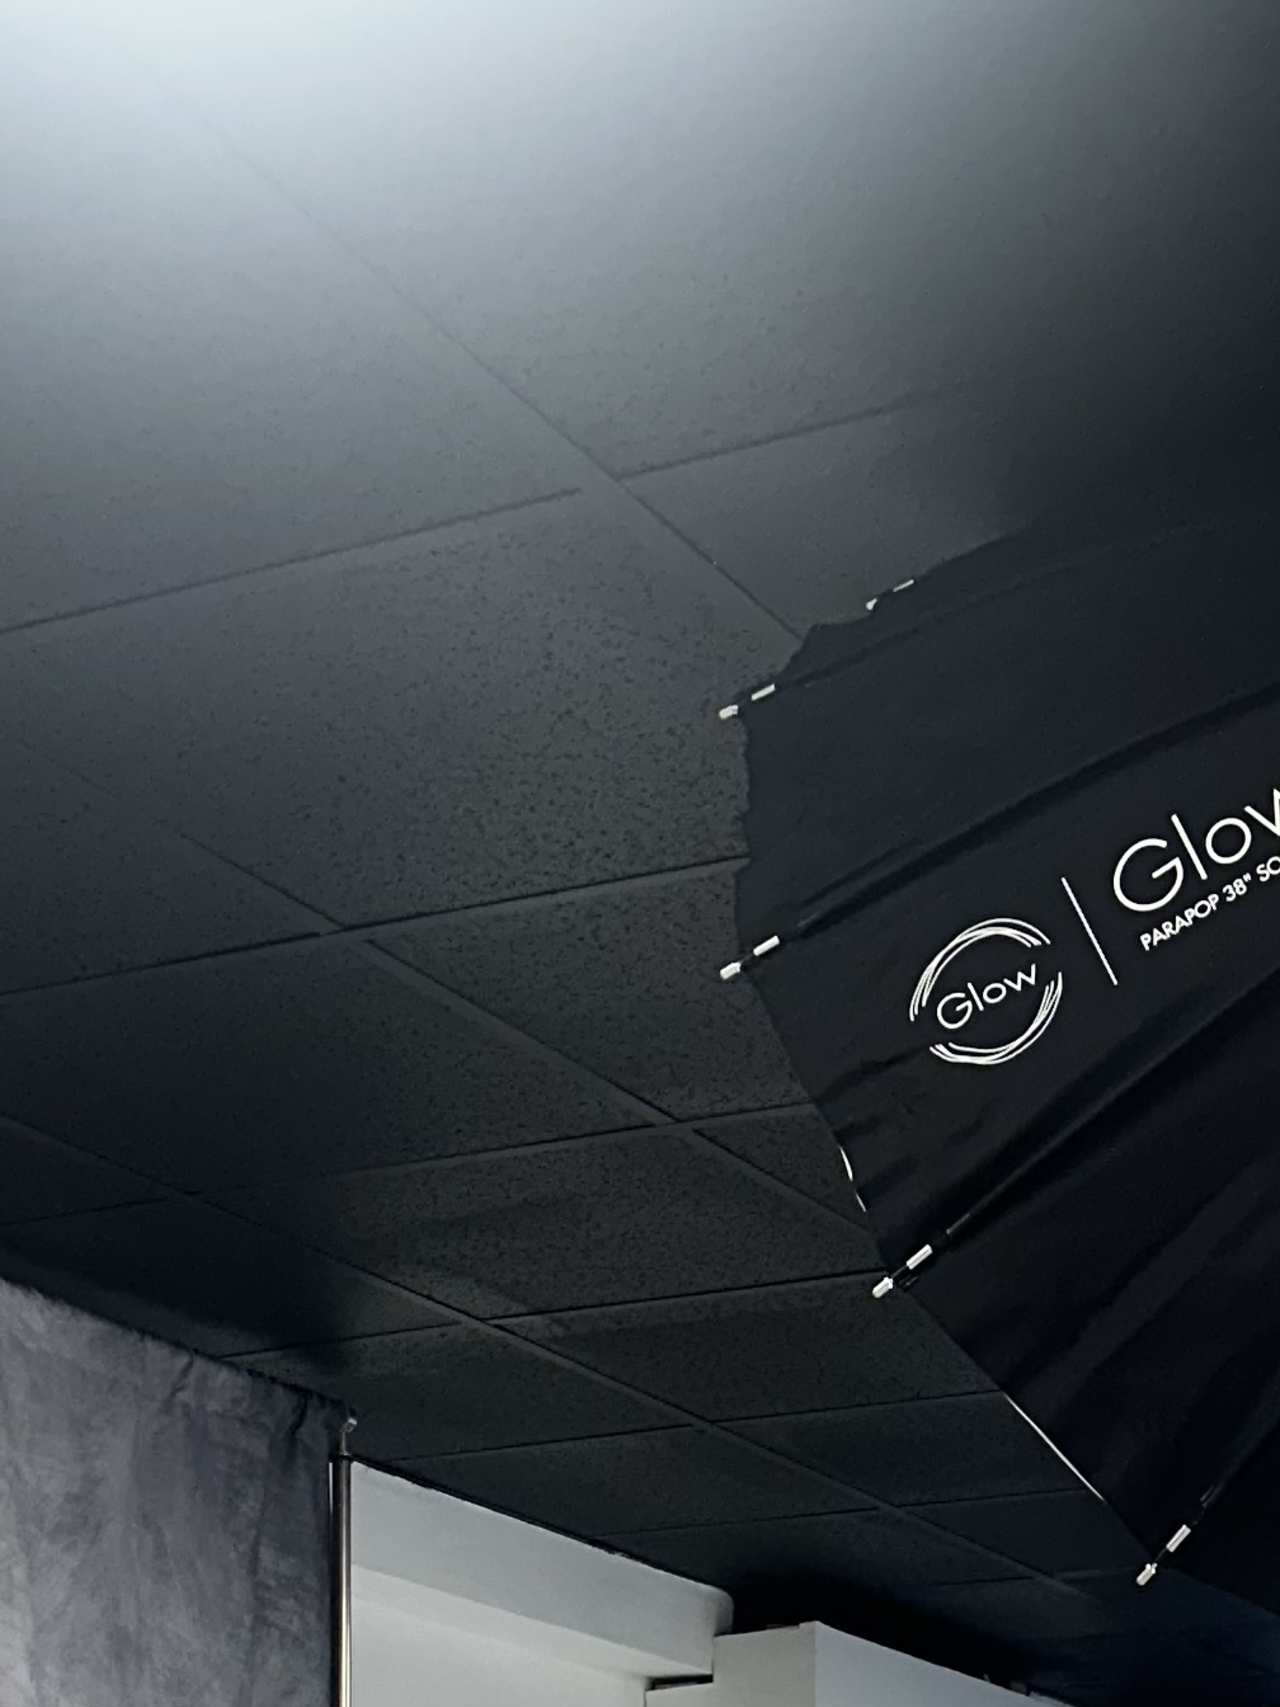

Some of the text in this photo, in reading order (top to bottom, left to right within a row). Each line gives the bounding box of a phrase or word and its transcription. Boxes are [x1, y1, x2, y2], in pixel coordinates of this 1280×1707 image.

[1139, 892, 1220, 952] PARAPOP
[1221, 872, 1253, 903] 38"
[935, 963, 1039, 1030] Glow
